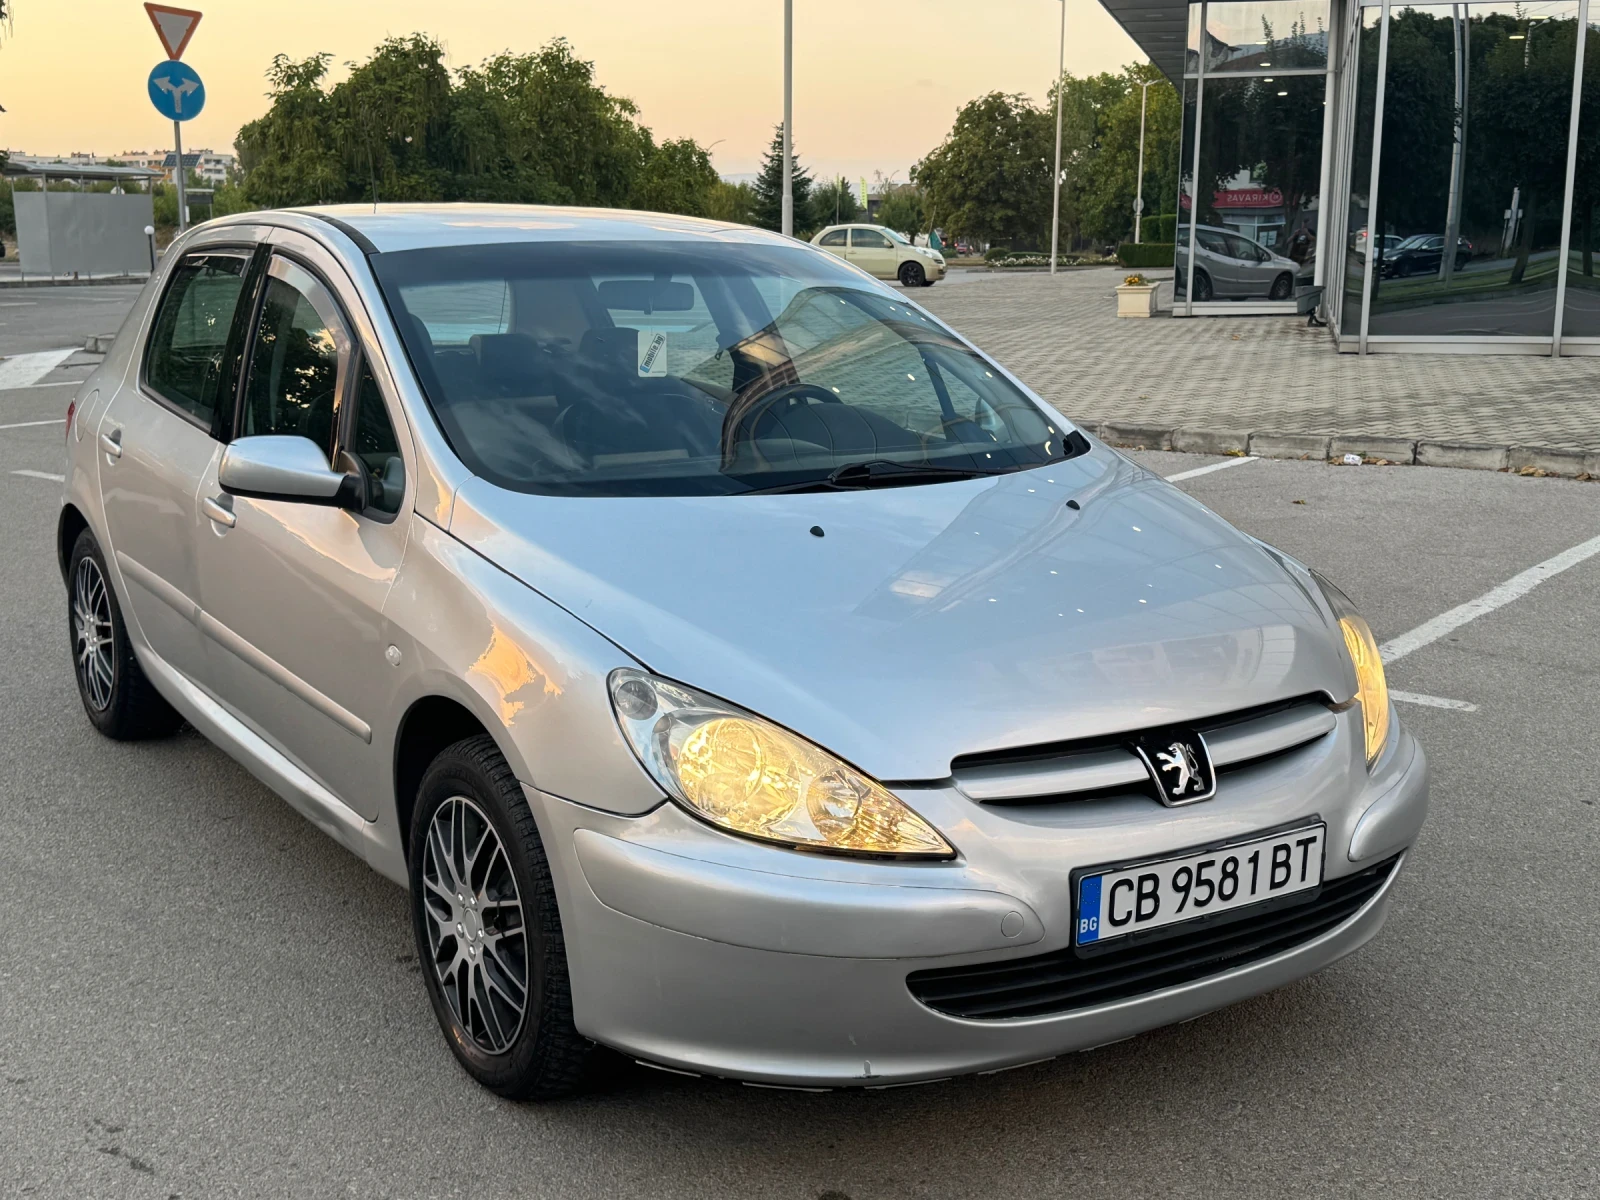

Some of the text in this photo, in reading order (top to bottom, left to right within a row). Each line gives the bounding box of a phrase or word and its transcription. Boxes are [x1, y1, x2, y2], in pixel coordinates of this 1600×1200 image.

[644, 335, 664, 367] mobile.bg
[1108, 872, 1160, 927] CB
[1171, 850, 1260, 914] 9581
[1080, 916, 1098, 934] BG
